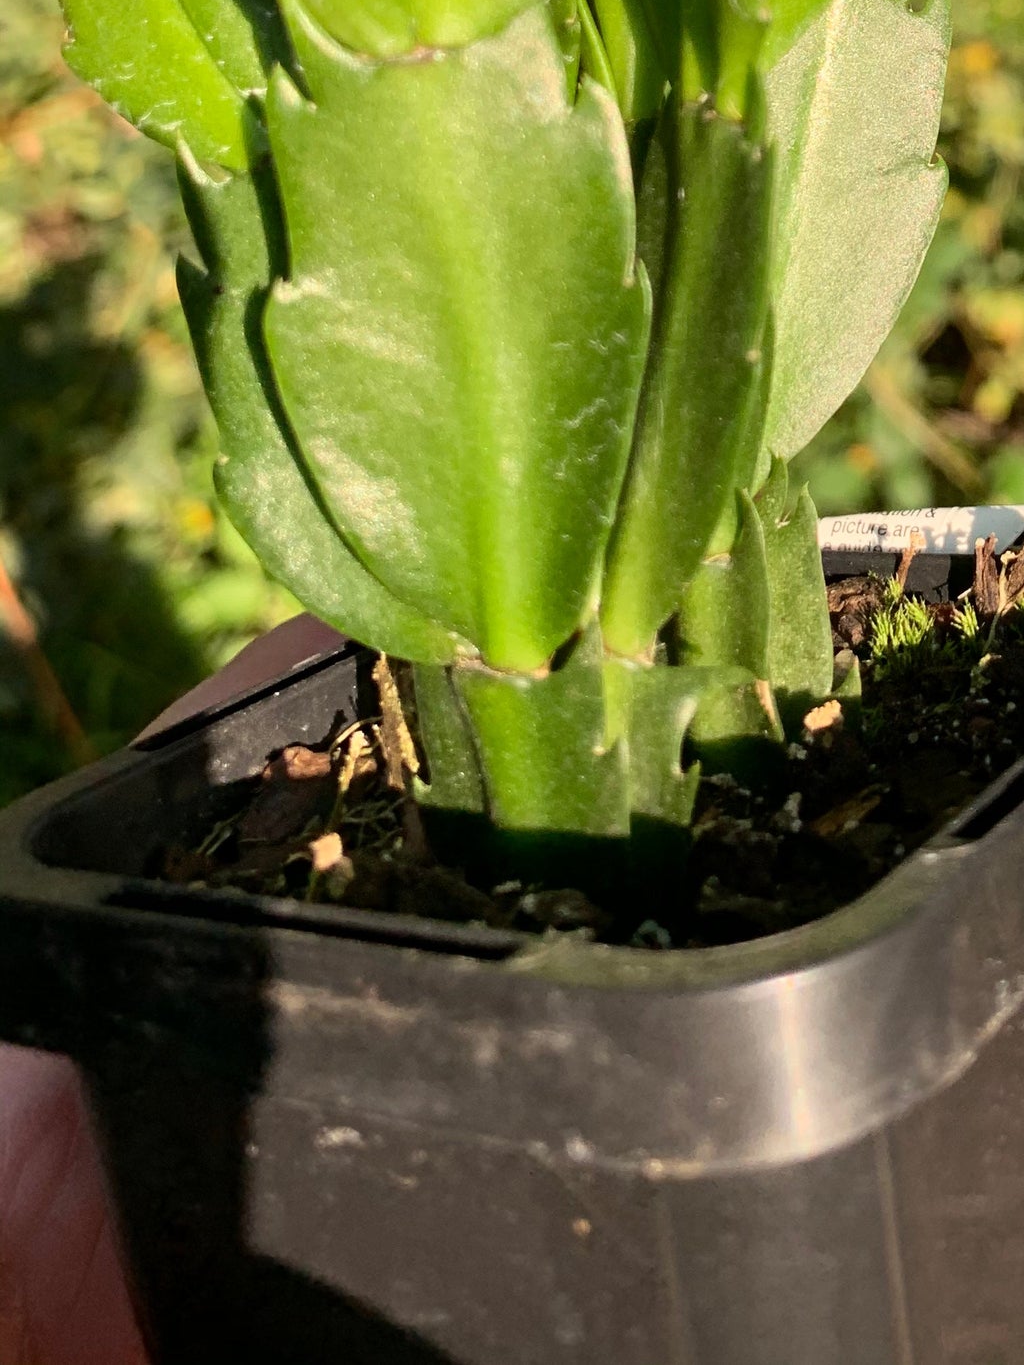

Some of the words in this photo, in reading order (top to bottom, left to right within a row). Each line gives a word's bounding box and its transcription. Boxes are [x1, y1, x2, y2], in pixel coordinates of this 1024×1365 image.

[925, 508, 936, 518] &
[831, 520, 888, 537] picture
[892, 525, 920, 538] are
